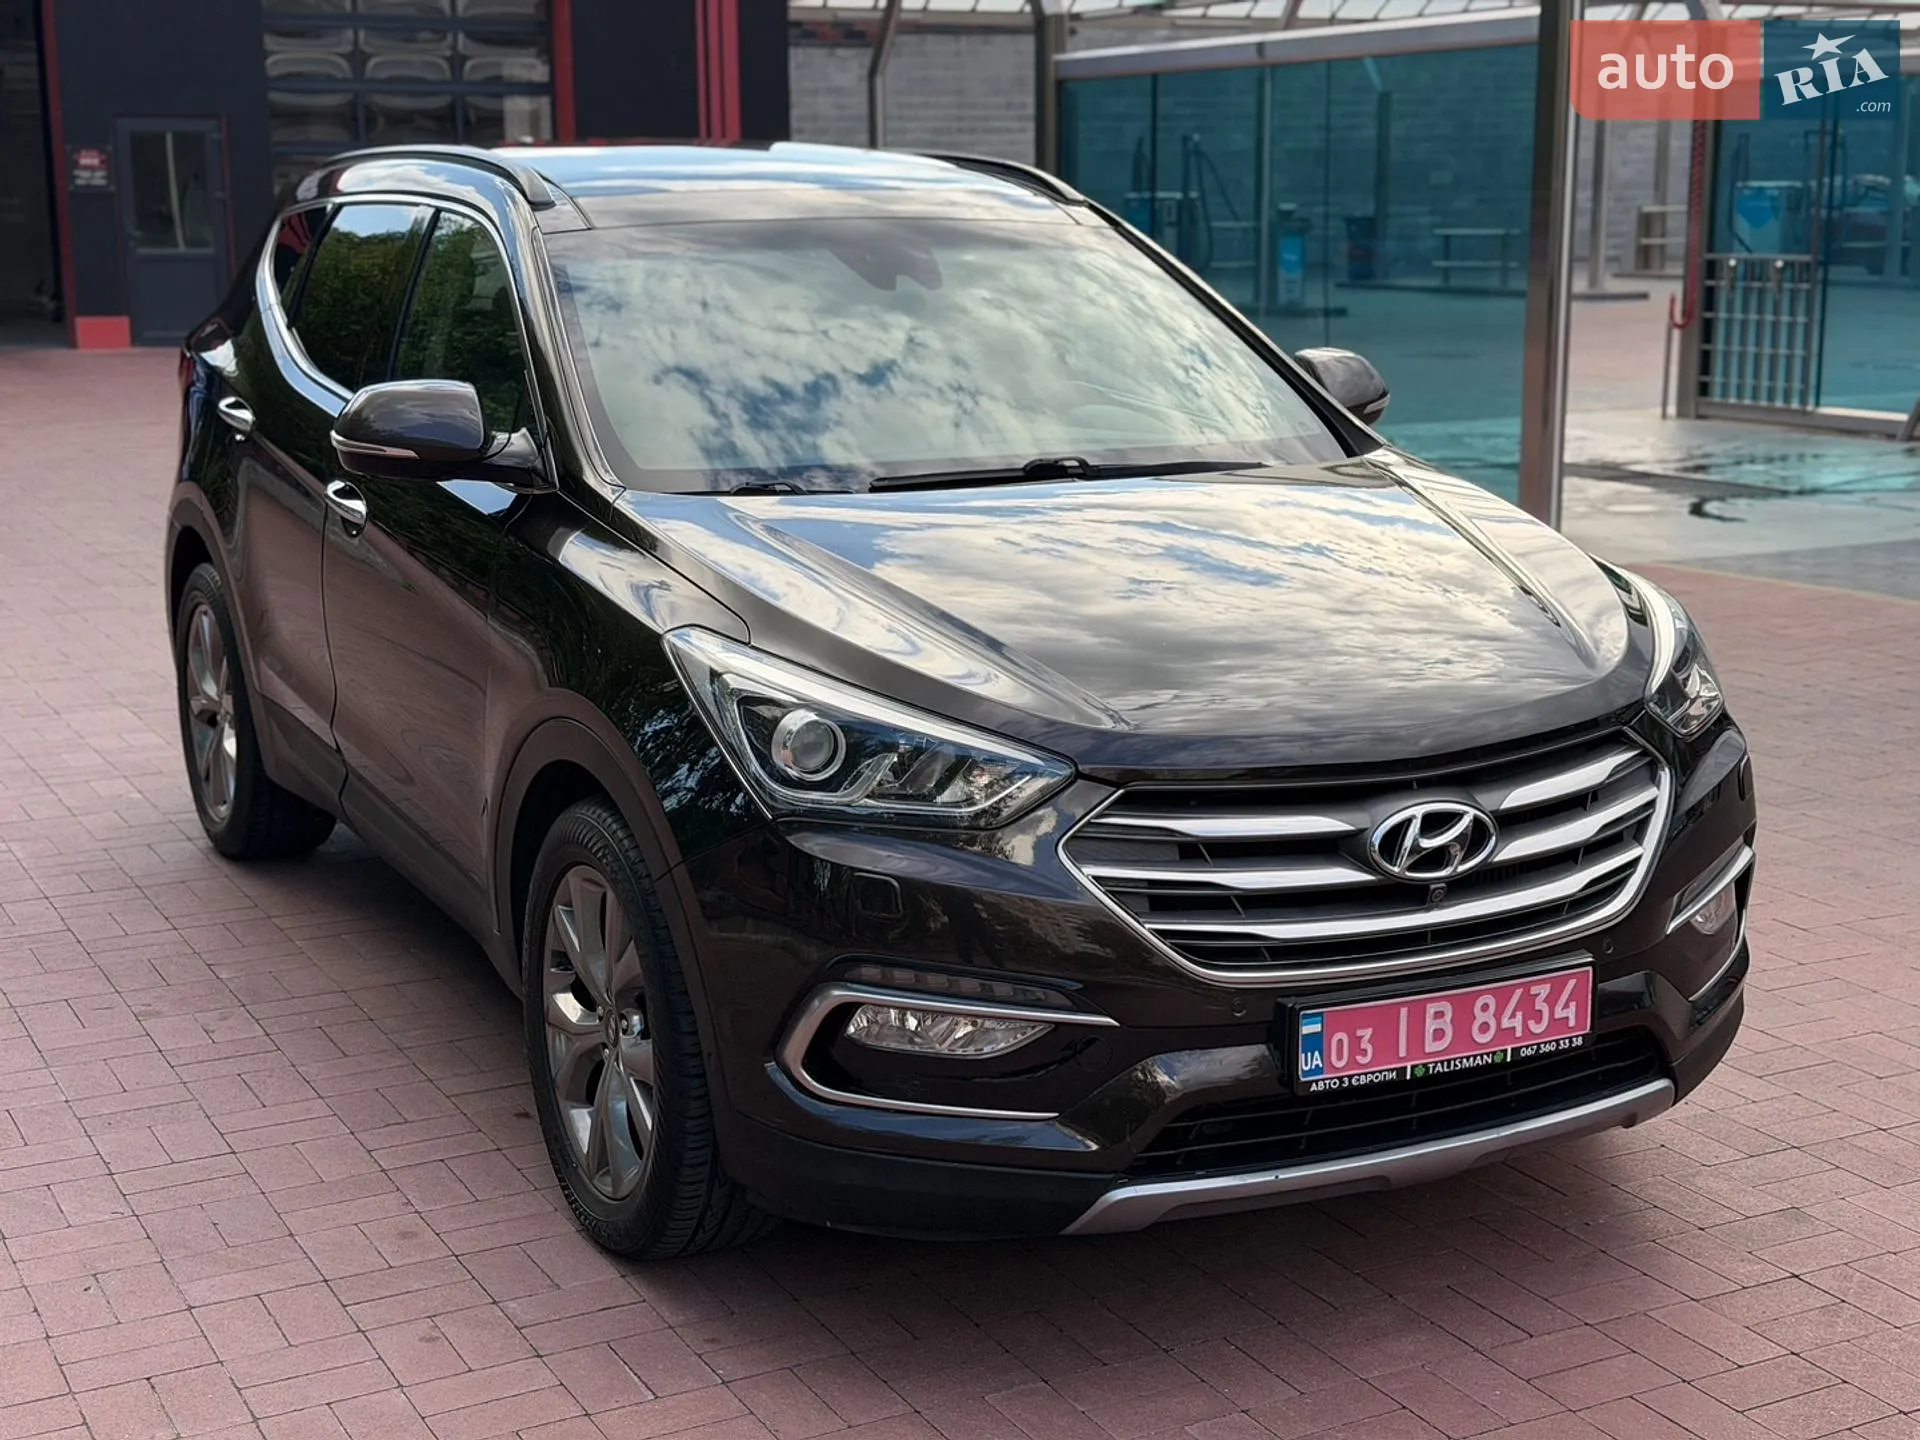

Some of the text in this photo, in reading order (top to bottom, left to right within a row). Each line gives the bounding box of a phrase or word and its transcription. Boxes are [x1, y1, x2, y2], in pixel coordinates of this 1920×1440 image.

[1329, 1027, 1374, 1069] 03
[1471, 978, 1577, 1045] 8434
[1520, 1036, 1583, 1057] 067 360 33 38
[1301, 1051, 1323, 1071] UA
[1427, 1053, 1493, 1075] TALISMAN
[1310, 1078, 1340, 1092] АВТО
[1351, 1070, 1397, 1086] ЄВРОПИ
